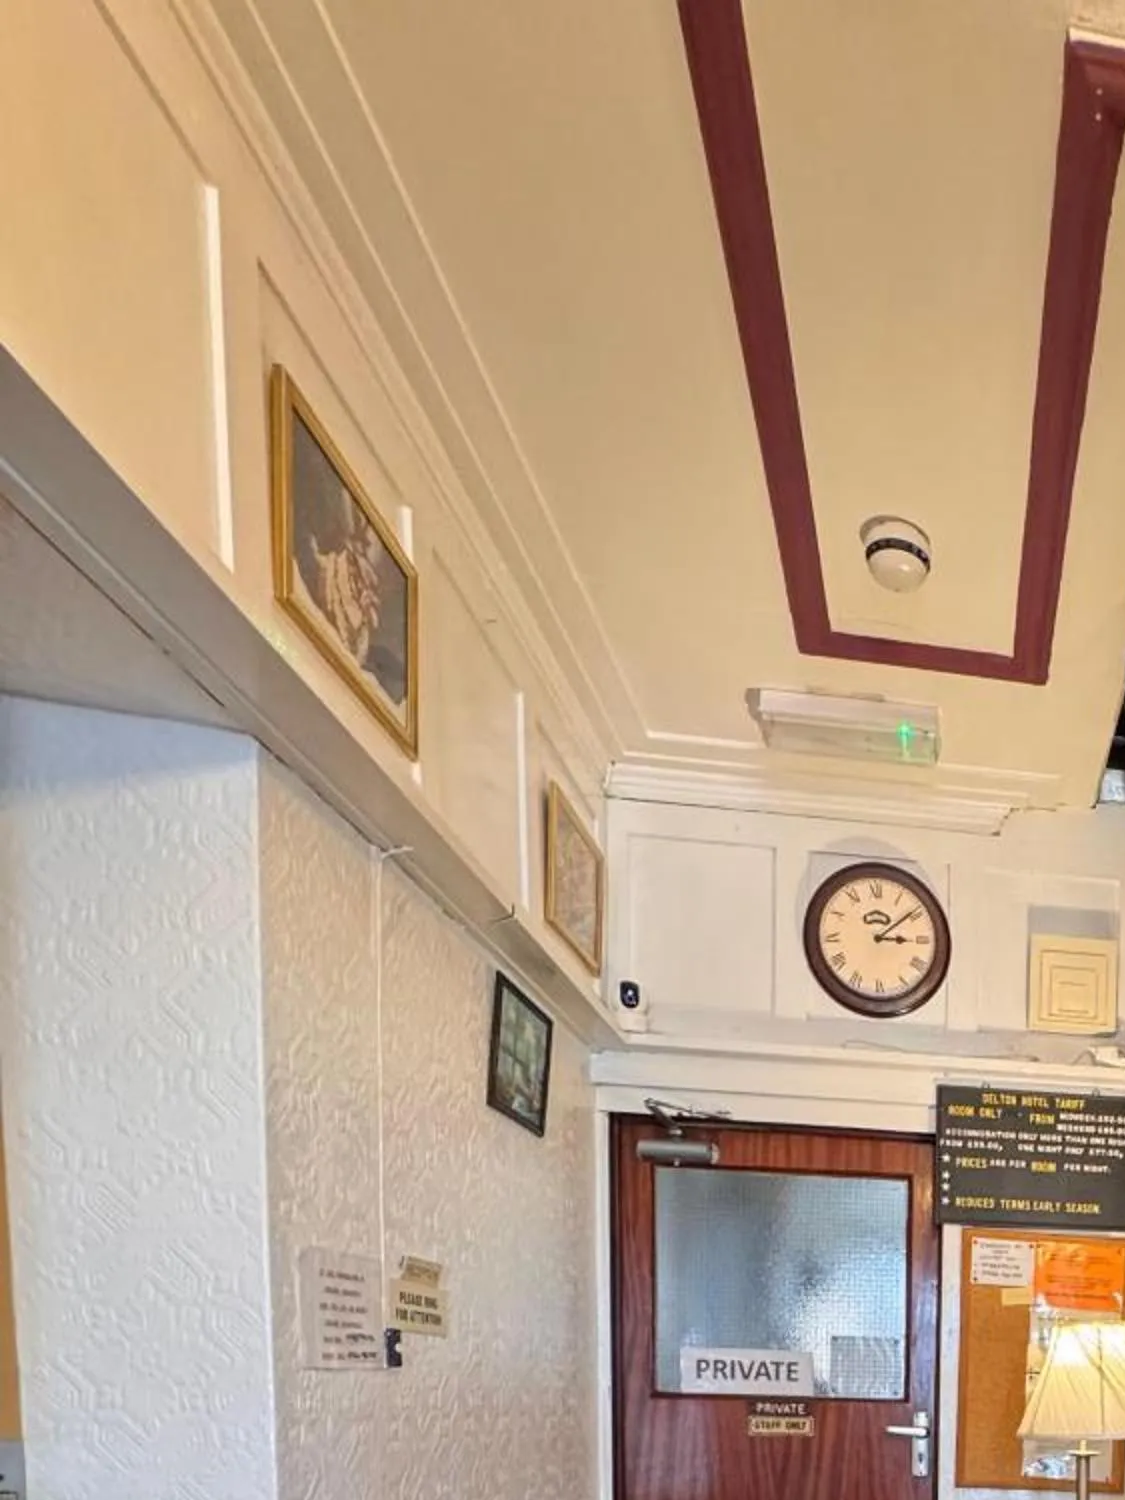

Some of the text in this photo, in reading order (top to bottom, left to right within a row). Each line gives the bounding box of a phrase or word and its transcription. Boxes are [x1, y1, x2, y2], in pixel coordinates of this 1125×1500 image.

[1029, 1113, 1056, 1125] FROM
[955, 1156, 988, 1169] PRICES
[955, 1196, 995, 1209] REDUCED
[1001, 1198, 1031, 1211] TERMS
[1033, 1200, 1061, 1212] EARLY
[399, 1291, 423, 1307] PLEASE
[395, 1307, 409, 1324] FOR
[695, 1358, 800, 1382] PRIVATE
[755, 1402, 808, 1415] PRIVATE
[753, 1420, 807, 1430] STAFF ONLY
